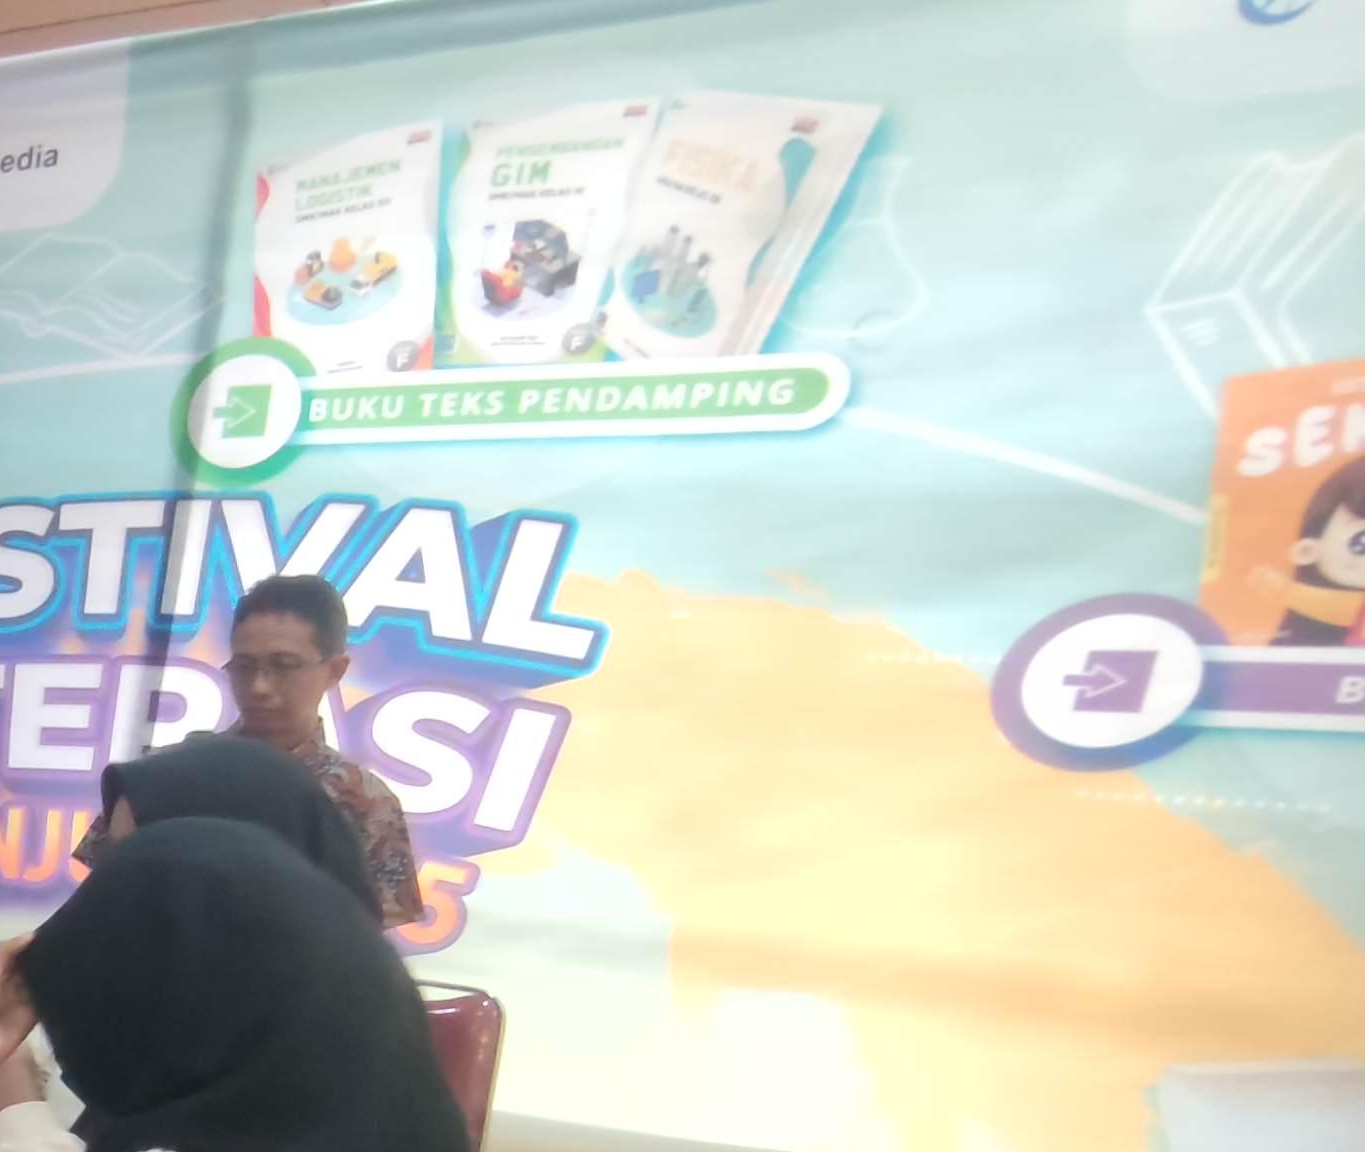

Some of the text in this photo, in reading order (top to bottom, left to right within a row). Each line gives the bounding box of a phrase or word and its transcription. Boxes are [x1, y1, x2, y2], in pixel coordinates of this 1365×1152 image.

[490, 160, 552, 187] GIM
[307, 376, 796, 424] BUKU TEKS PENDAMPING
